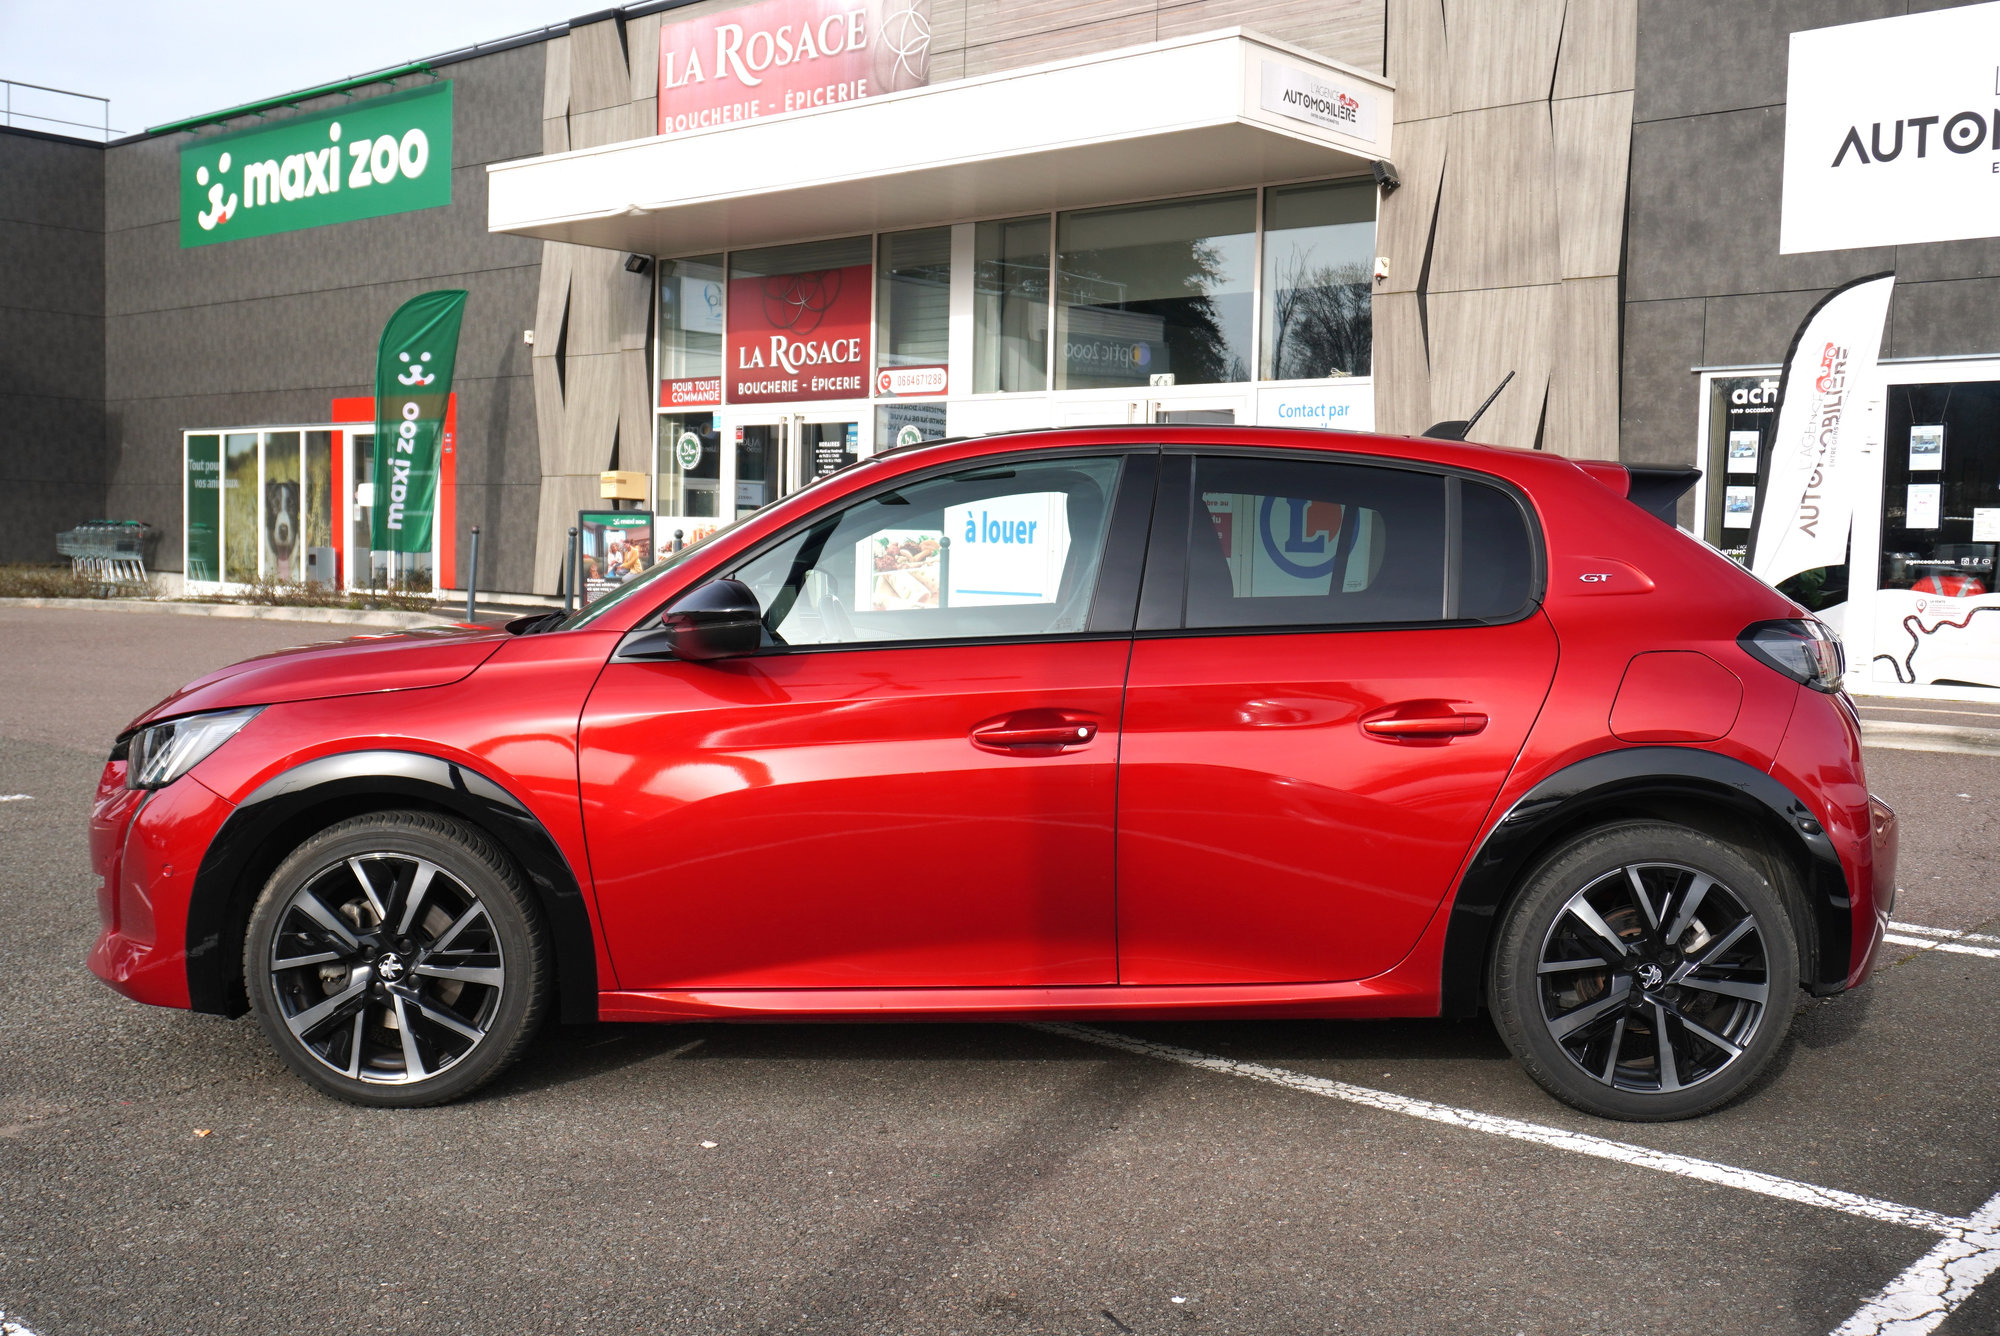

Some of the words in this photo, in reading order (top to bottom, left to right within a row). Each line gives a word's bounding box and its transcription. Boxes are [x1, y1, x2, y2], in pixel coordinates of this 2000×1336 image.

[665, 47, 705, 89] LA
[714, 8, 868, 87] ROSACE
[665, 100, 760, 133] BOUCHERIE
[784, 79, 868, 112] ÉPICERIE
[1831, 109, 2000, 168] AUTO
[243, 121, 341, 209] maxi
[347, 127, 430, 189] zoo
[739, 346, 765, 369] LA
[769, 335, 861, 374] ROSACE
[672, 382, 692, 392] POUR
[694, 380, 720, 391] TOUTE
[738, 379, 798, 395] BOUCHERIE
[811, 375, 861, 391] ÉPICERIE
[897, 374, 942, 387] 0664671288
[672, 390, 720, 404] COMMANDE
[1278, 403, 1325, 418] Contact
[1329, 405, 1350, 420] par
[396, 402, 420, 455] zoo
[188, 459, 204, 471] Tout
[205, 461, 220, 474] pou
[194, 480, 206, 488] vos
[387, 457, 411, 530] maxi
[965, 511, 976, 544] à
[982, 511, 1037, 544] louer
[1579, 573, 1613, 584] GT
